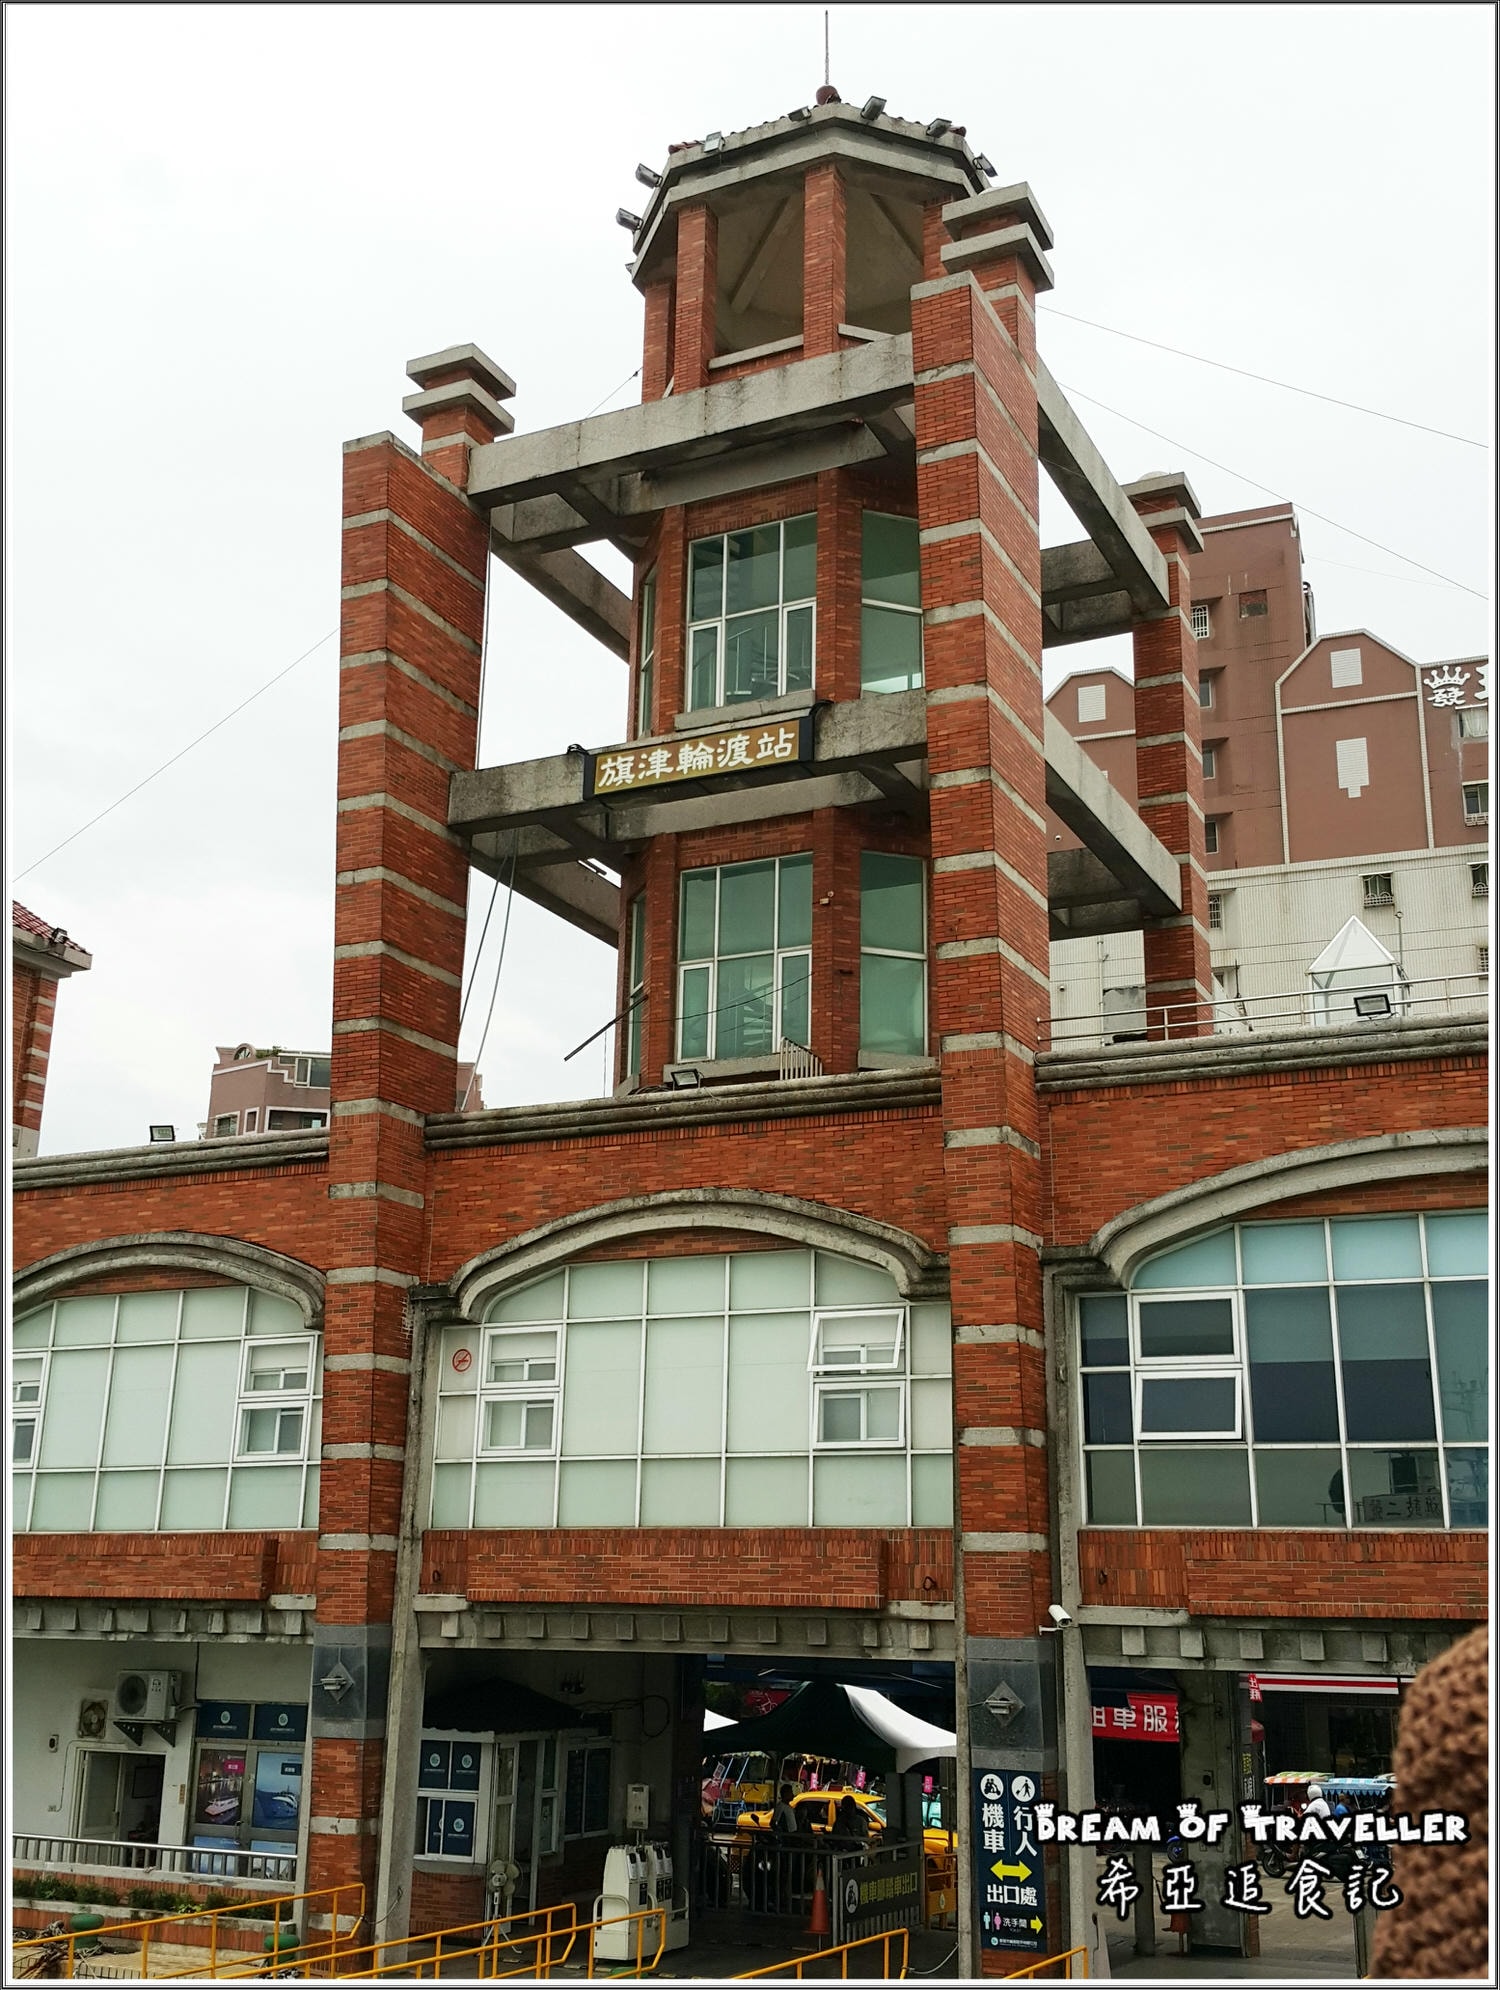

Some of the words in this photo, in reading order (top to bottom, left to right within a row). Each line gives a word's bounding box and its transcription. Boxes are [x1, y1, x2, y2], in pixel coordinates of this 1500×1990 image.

[598, 727, 796, 787] 旗津輪渡站
[1092, 1703, 1179, 1733] 車服
[982, 1804, 1006, 1853] 機車
[1014, 1806, 1037, 1856] 行人
[986, 1884, 1038, 1907] 出口處
